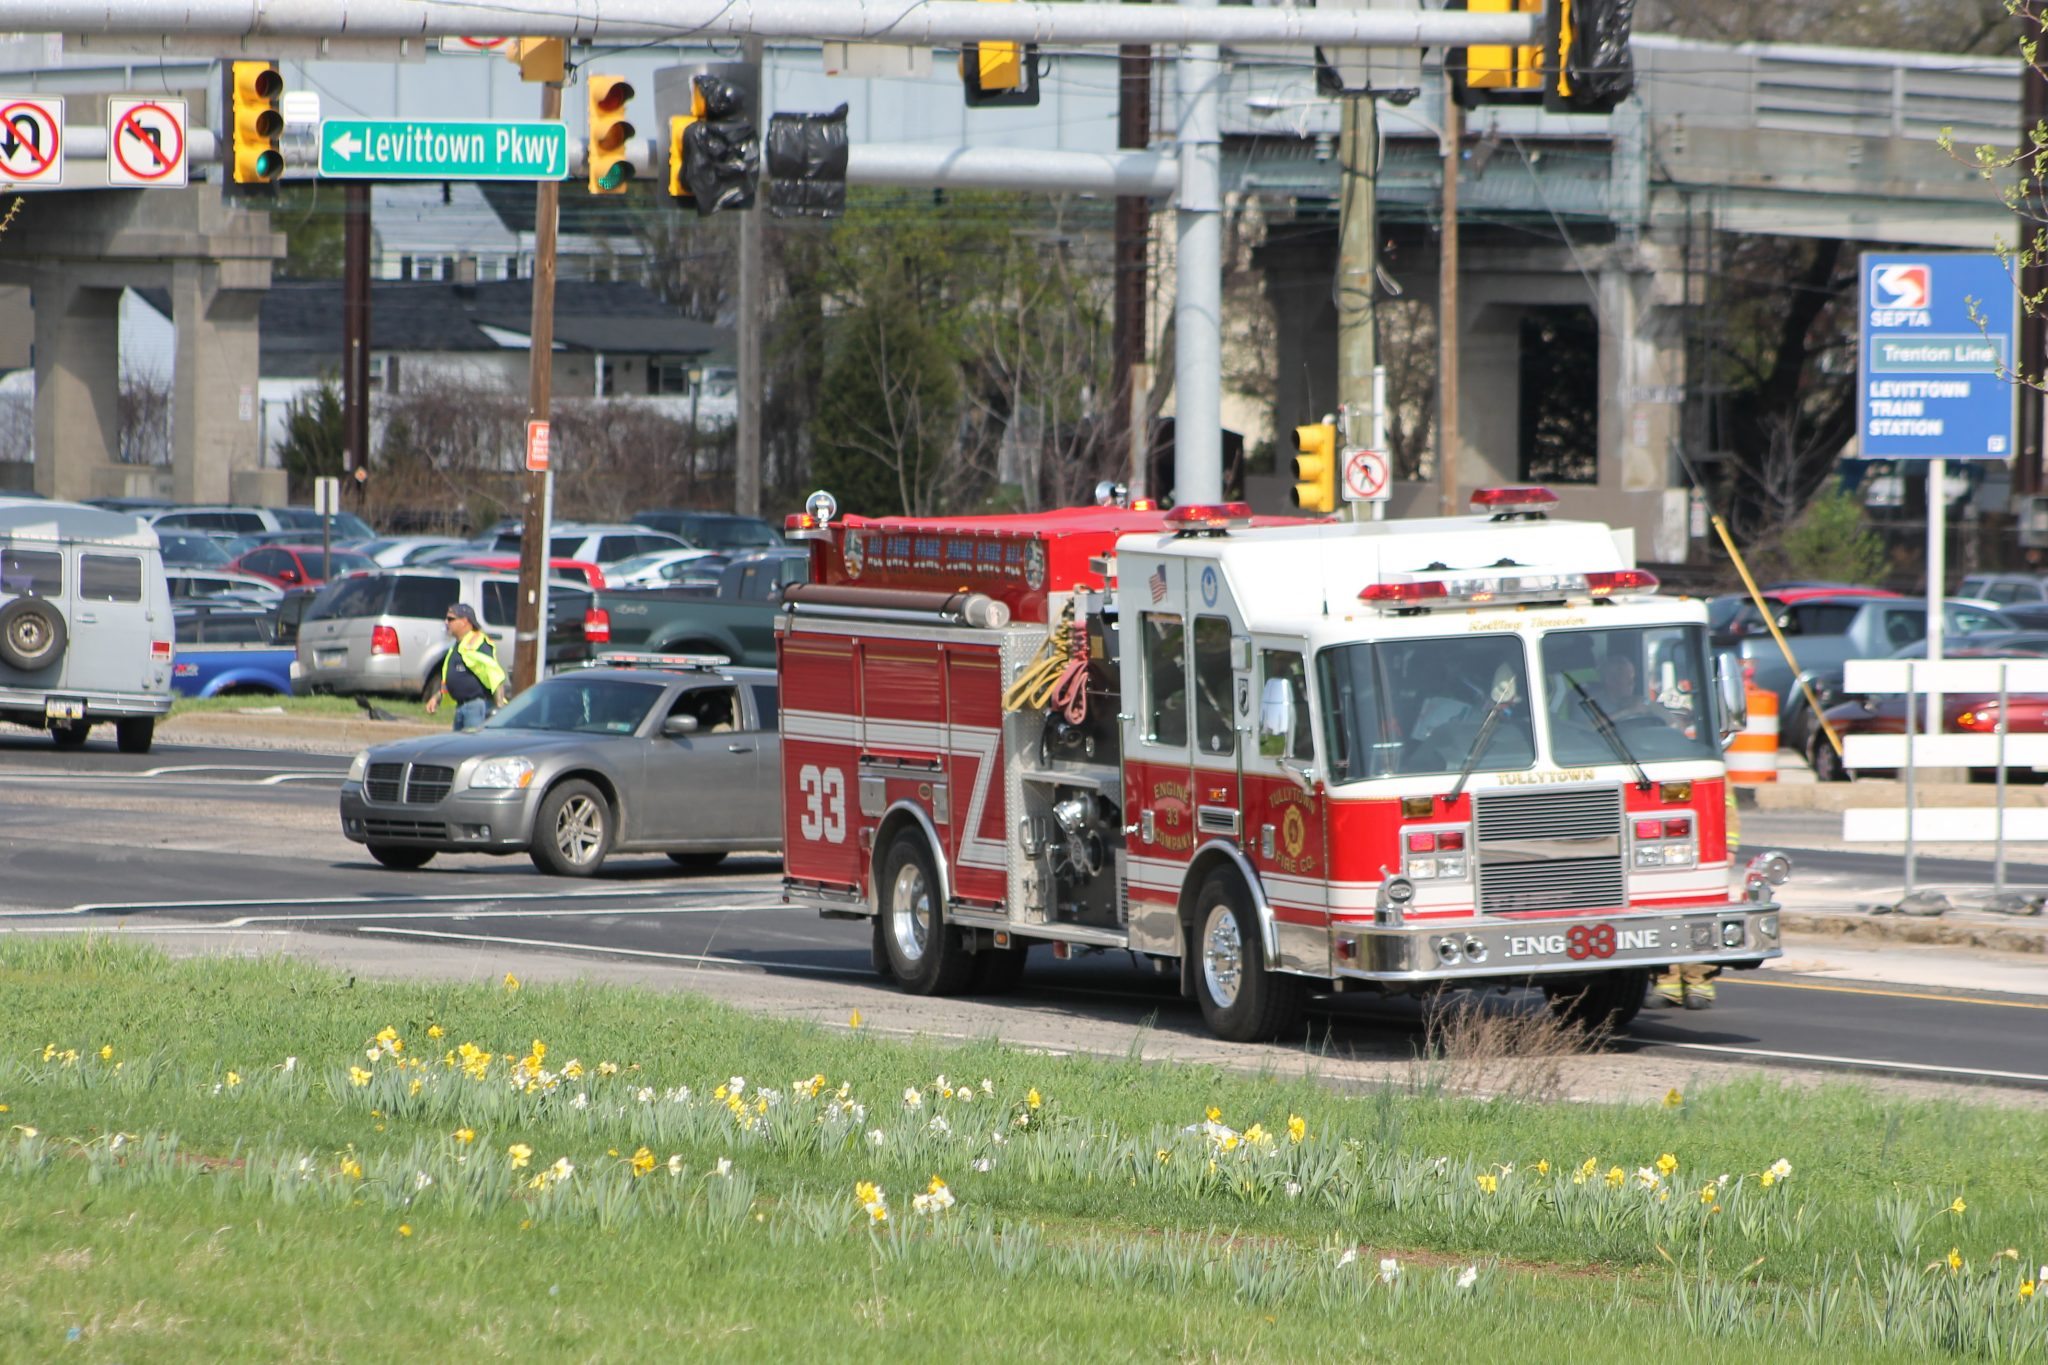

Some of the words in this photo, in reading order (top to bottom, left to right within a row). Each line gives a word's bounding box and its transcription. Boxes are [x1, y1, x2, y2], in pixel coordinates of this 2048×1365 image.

[364, 125, 485, 163] Levittown
[496, 127, 559, 174] Pkwy
[1870, 310, 1932, 327] SEPTA
[1883, 344, 1951, 362] Trenton
[1955, 346, 1995, 362] Line
[1869, 380, 1970, 398] LEVITTOWN
[1869, 400, 1924, 417] TRAIN
[1869, 418, 1944, 436] STATION
[1497, 769, 1596, 786] TULLYTOWN
[1153, 782, 1189, 804] ENGINE
[1269, 787, 1316, 815] TULLYTOWN
[799, 764, 846, 844] 33
[1166, 807, 1179, 827] 33
[1275, 851, 1298, 874] FIRE
